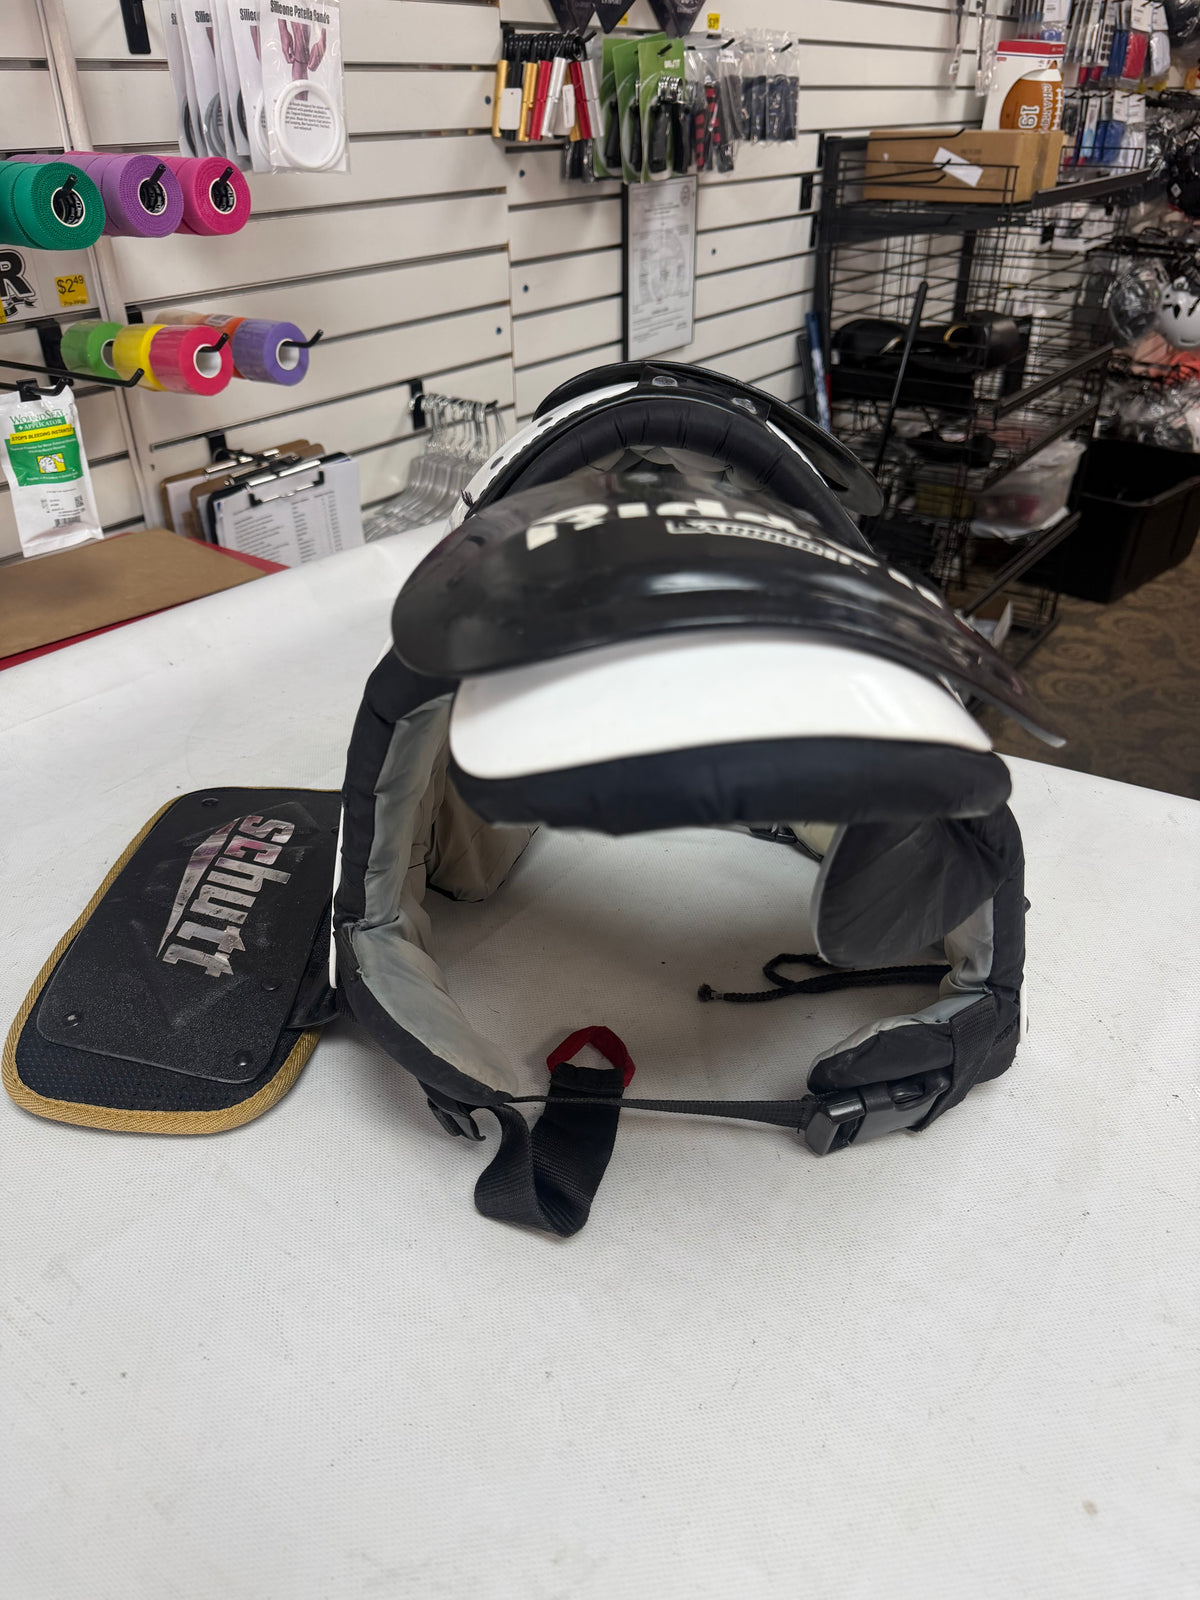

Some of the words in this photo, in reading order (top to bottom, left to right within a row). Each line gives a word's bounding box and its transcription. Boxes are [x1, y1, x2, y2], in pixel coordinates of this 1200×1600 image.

[270, 0, 293, 16] Silicone
[294, 5, 312, 20] Patella
[1018, 105, 1040, 129] 19
